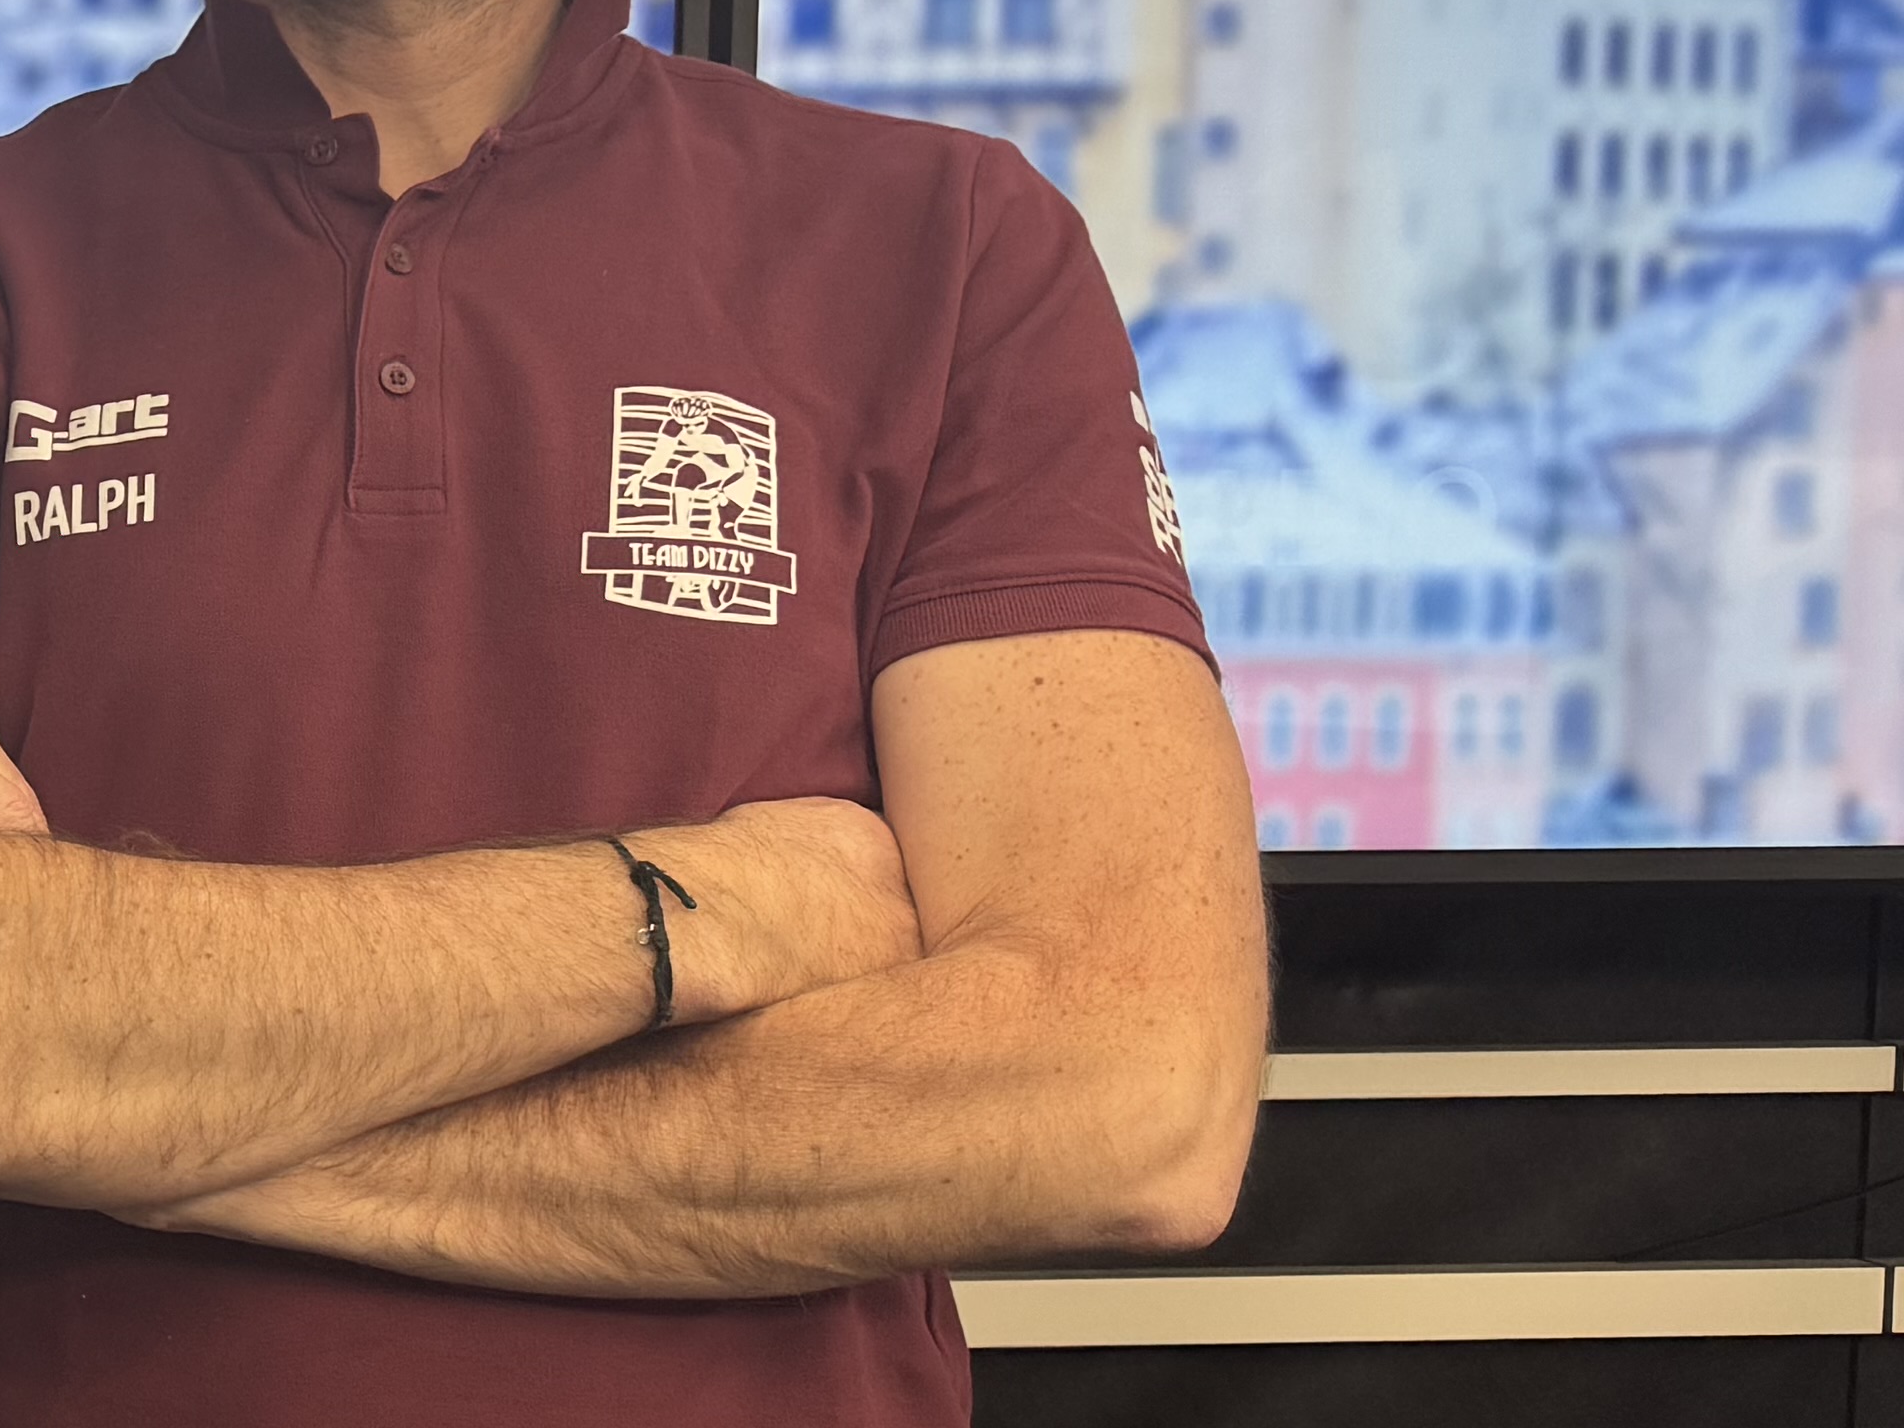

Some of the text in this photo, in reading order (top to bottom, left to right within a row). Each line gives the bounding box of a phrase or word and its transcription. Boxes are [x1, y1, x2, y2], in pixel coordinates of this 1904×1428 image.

[14, 473, 156, 546] RALPH
[628, 542, 755, 575] TEAM DIZZY
